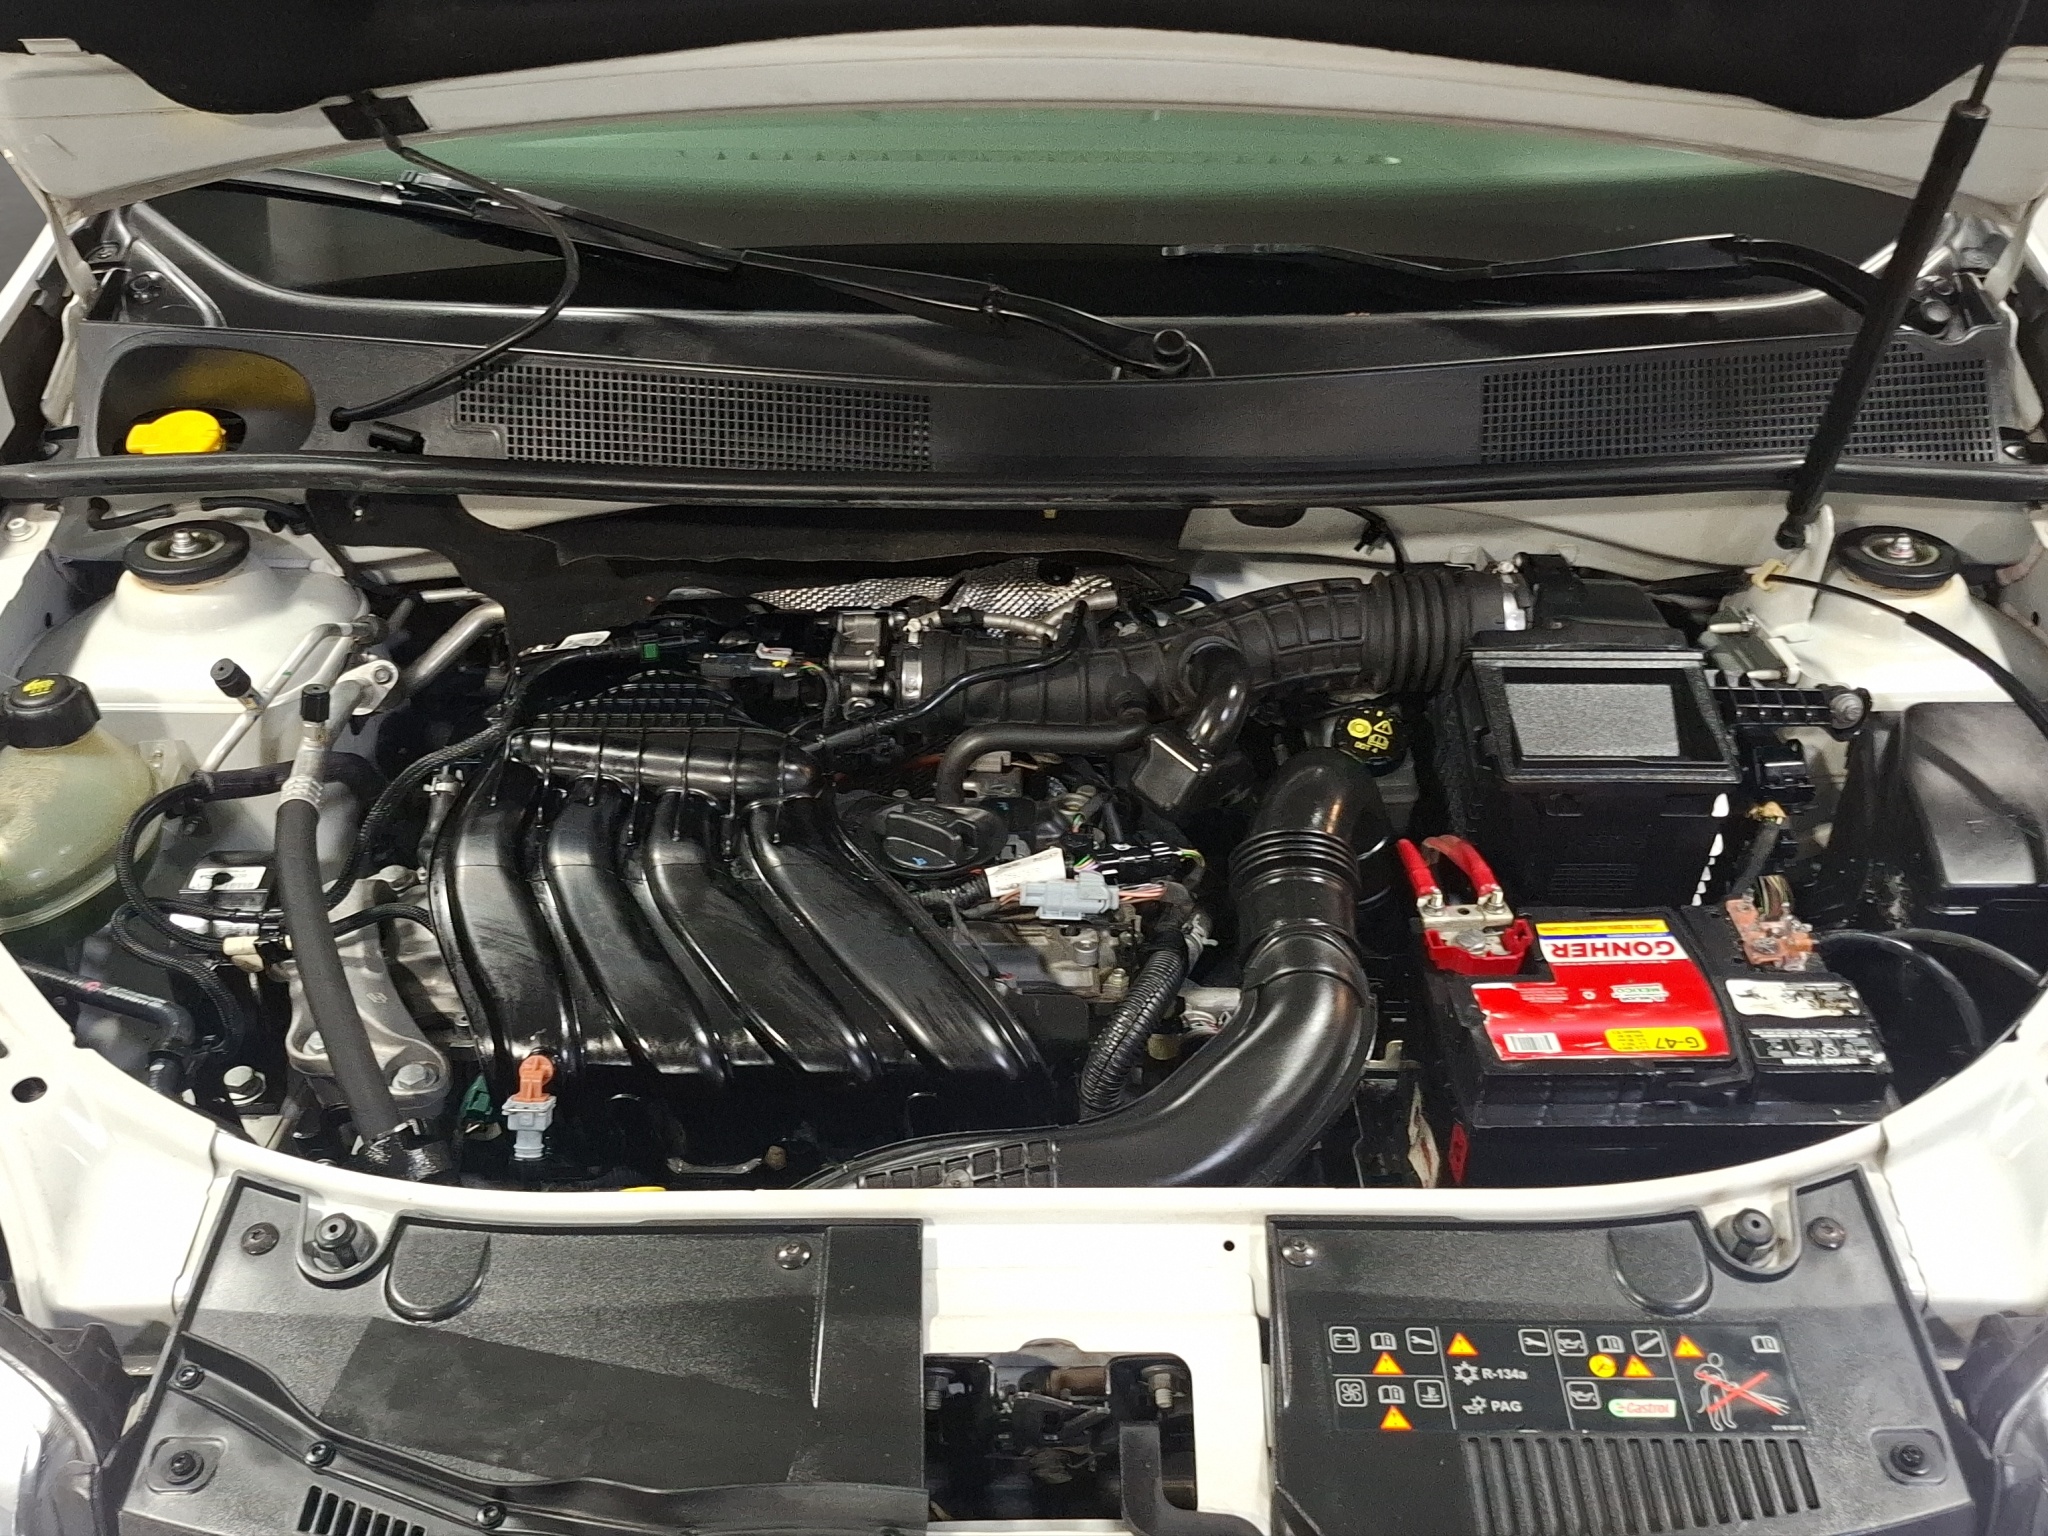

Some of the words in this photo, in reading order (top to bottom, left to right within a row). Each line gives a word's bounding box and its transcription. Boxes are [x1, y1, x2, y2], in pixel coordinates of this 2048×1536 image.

[1550, 940, 1675, 958] GONHER
[1655, 1036, 1700, 1050] G-47
[1481, 1367, 1528, 1381] R-134a
[1490, 1400, 1523, 1413] PAG
[1626, 1401, 1670, 1414] Castrol
